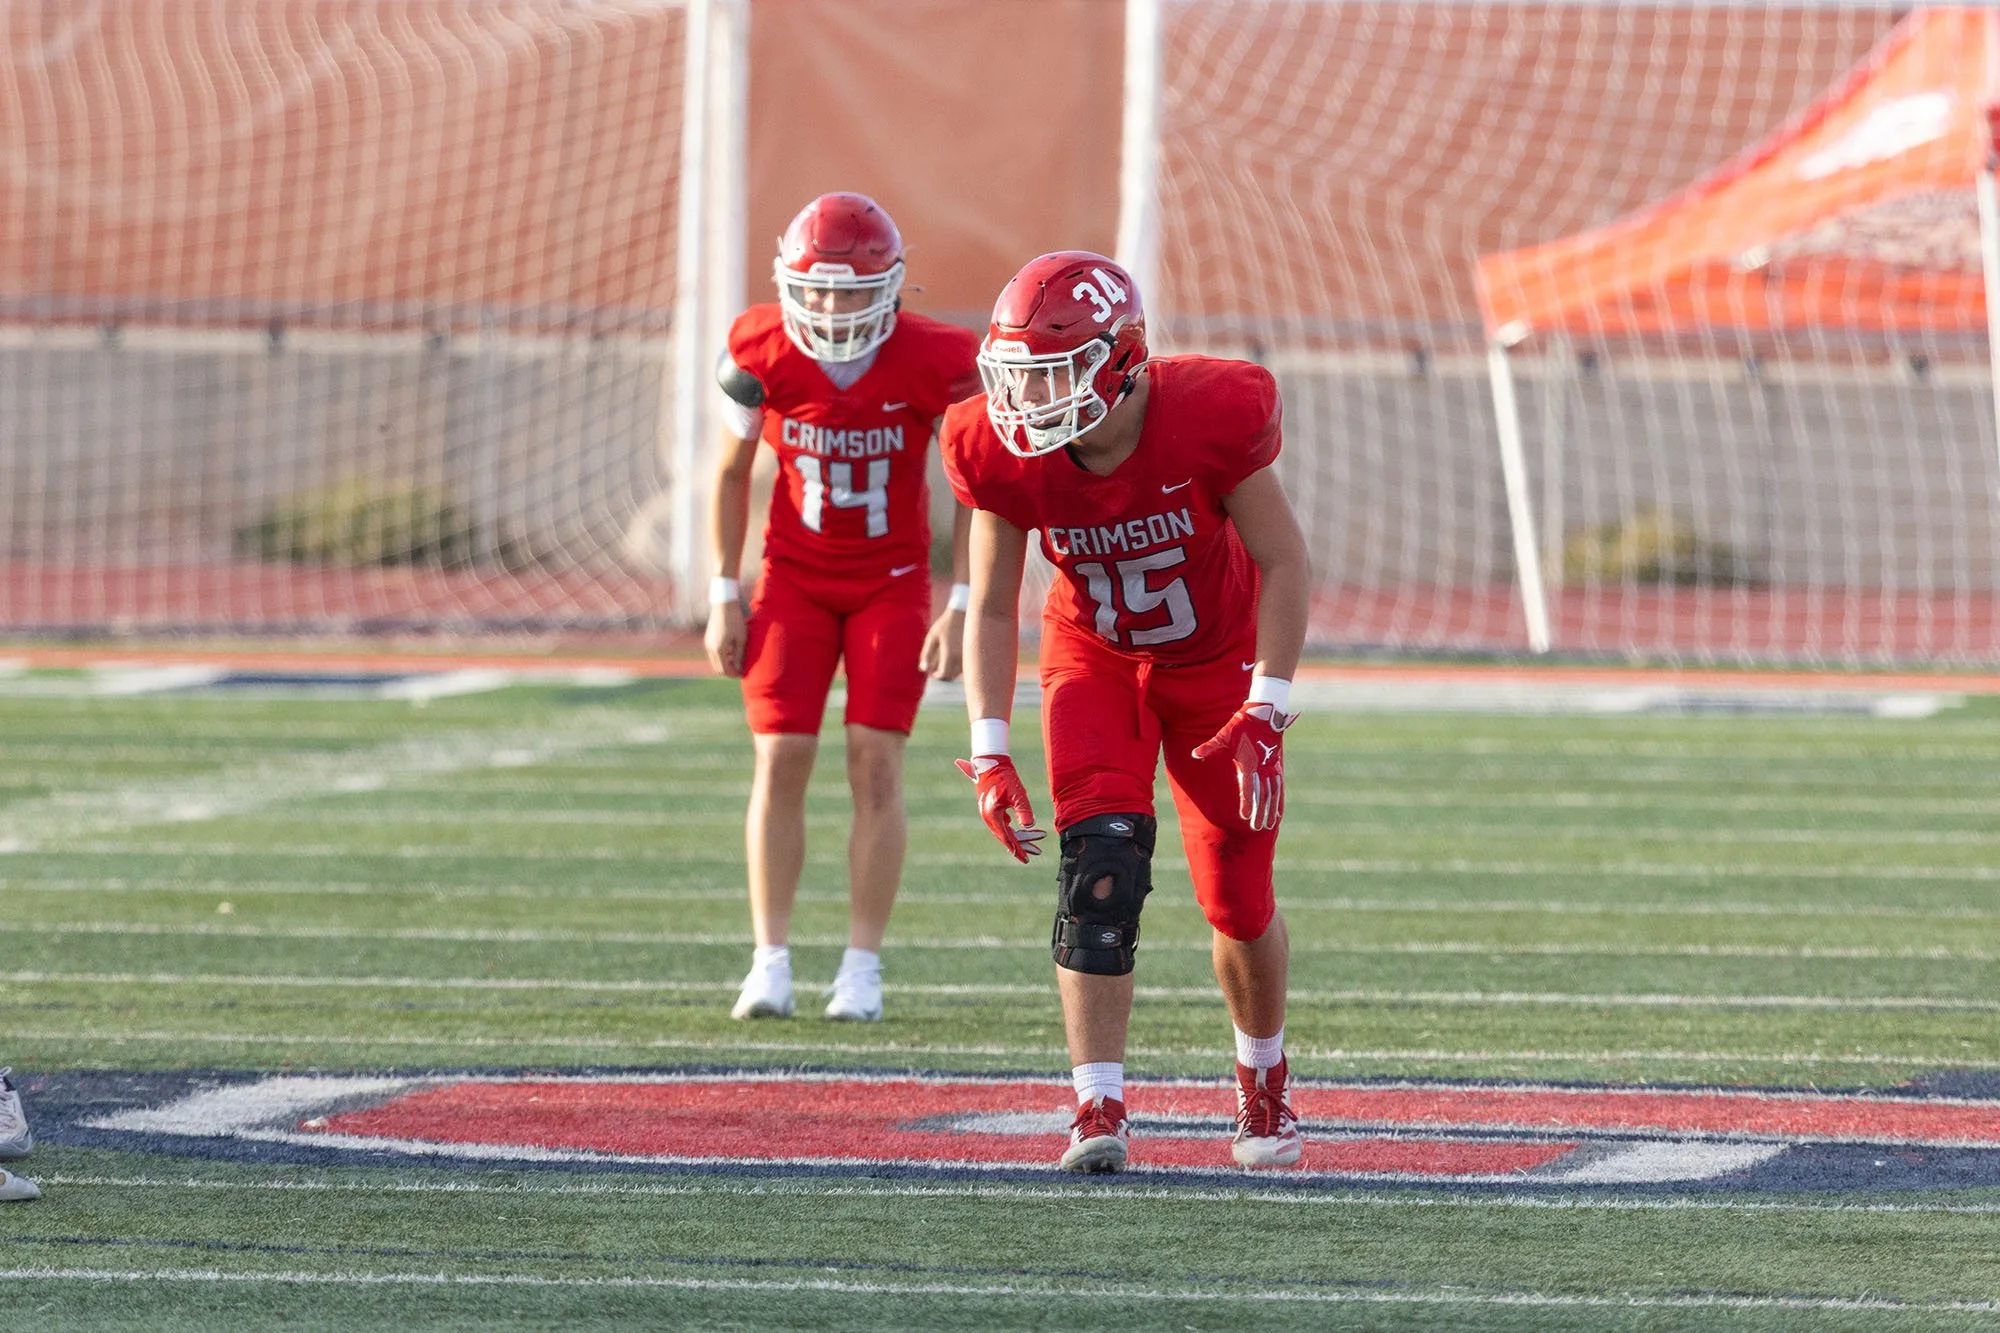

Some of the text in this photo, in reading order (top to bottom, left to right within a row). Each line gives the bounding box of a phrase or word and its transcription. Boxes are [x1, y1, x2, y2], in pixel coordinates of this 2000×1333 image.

[1072, 267, 1128, 323] 34
[782, 416, 905, 459] CRIMSON
[794, 454, 890, 539] 14
[1048, 507, 1196, 556] CRIMSON
[1074, 546, 1198, 646] 15
